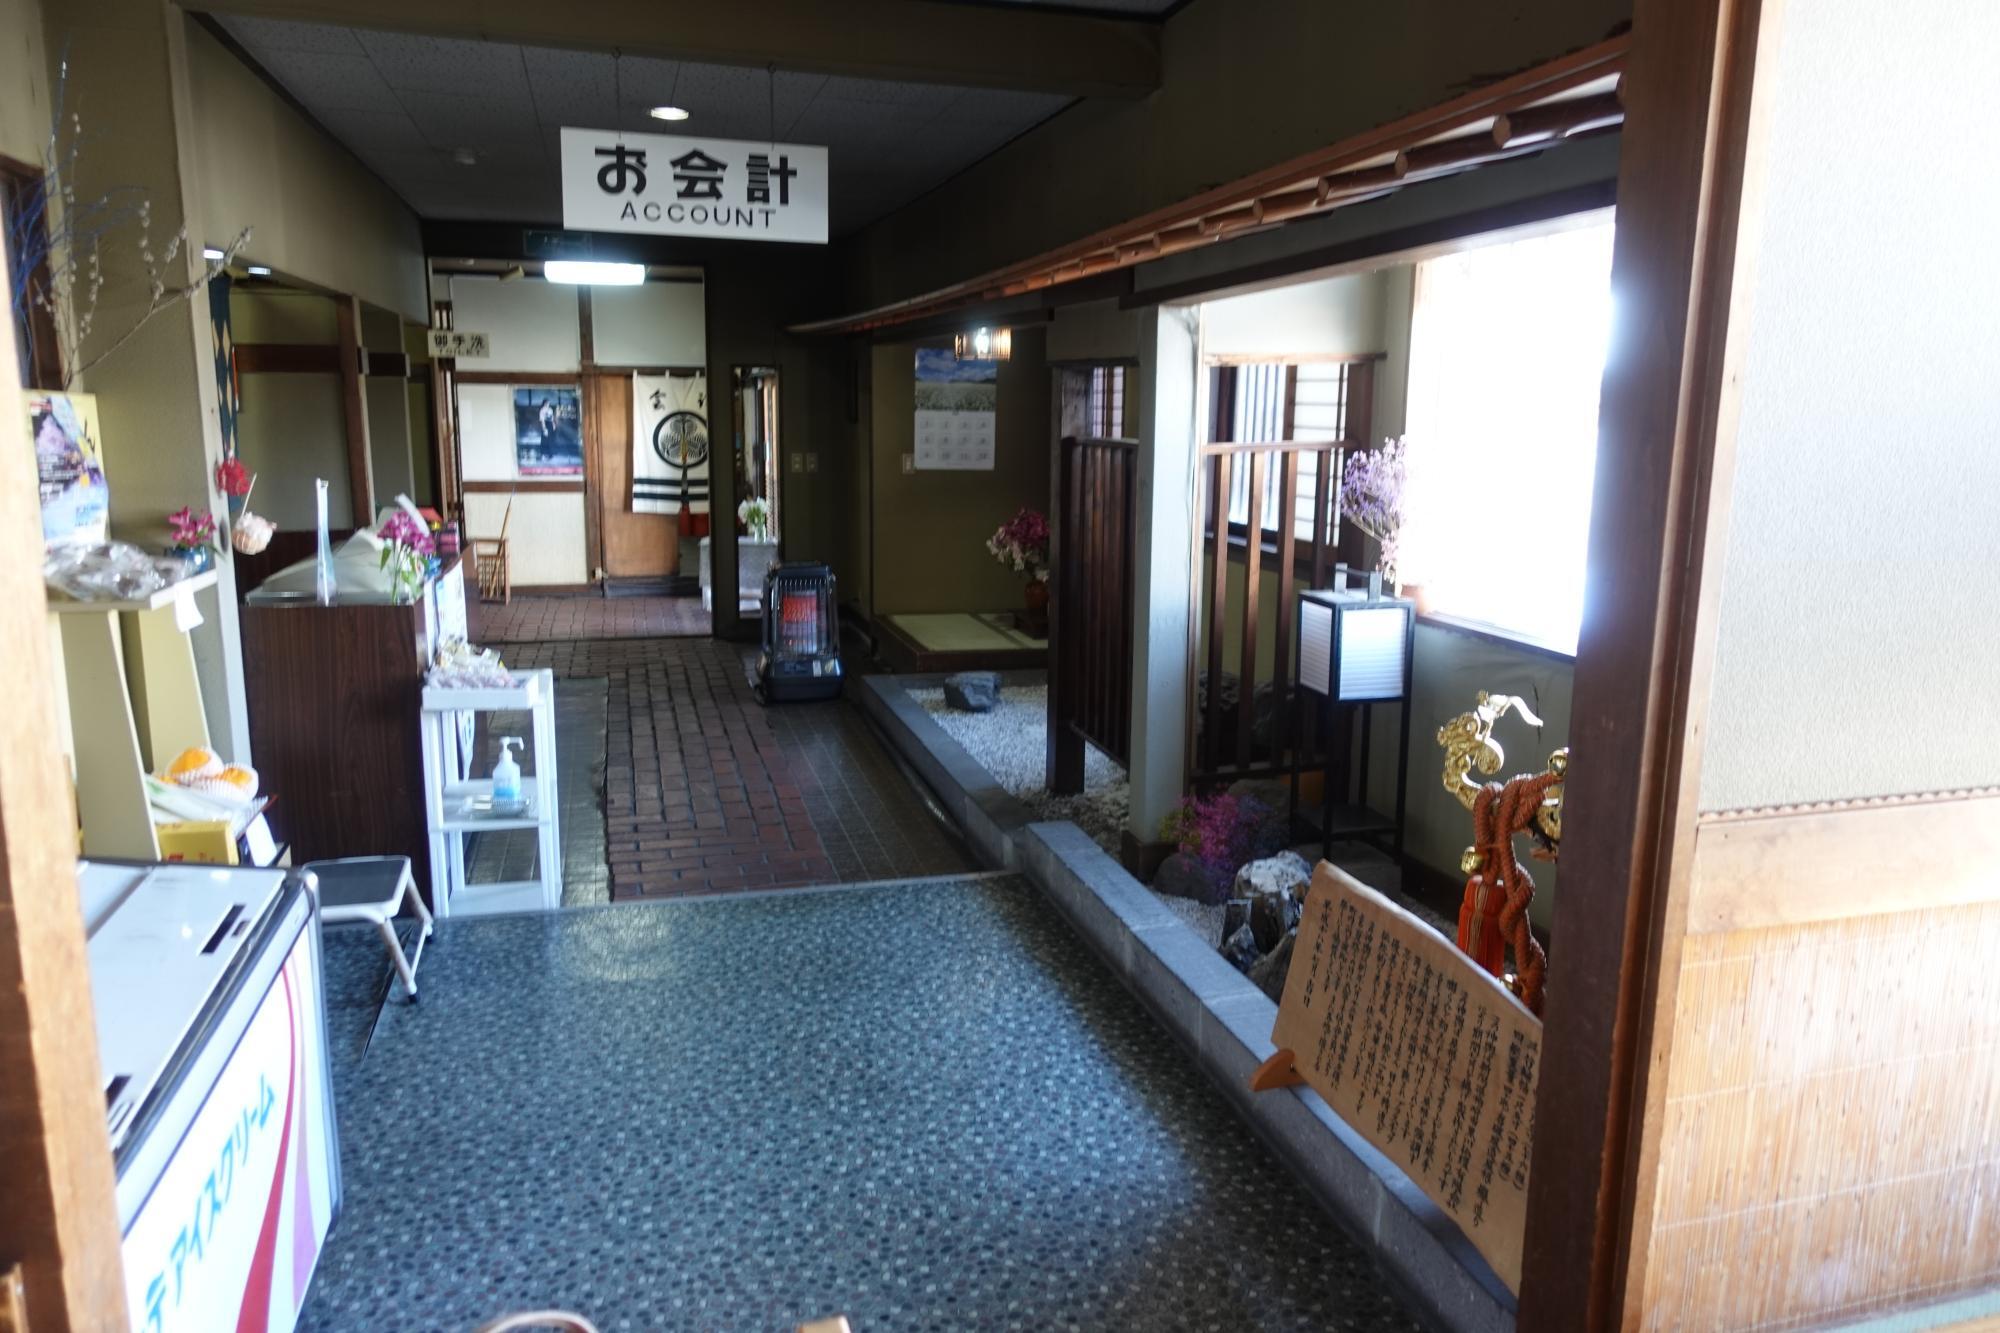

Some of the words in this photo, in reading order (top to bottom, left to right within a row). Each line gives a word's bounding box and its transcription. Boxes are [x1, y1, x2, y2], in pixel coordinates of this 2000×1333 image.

[594, 143, 797, 206] お会計
[620, 201, 777, 229] ACCOUNT
